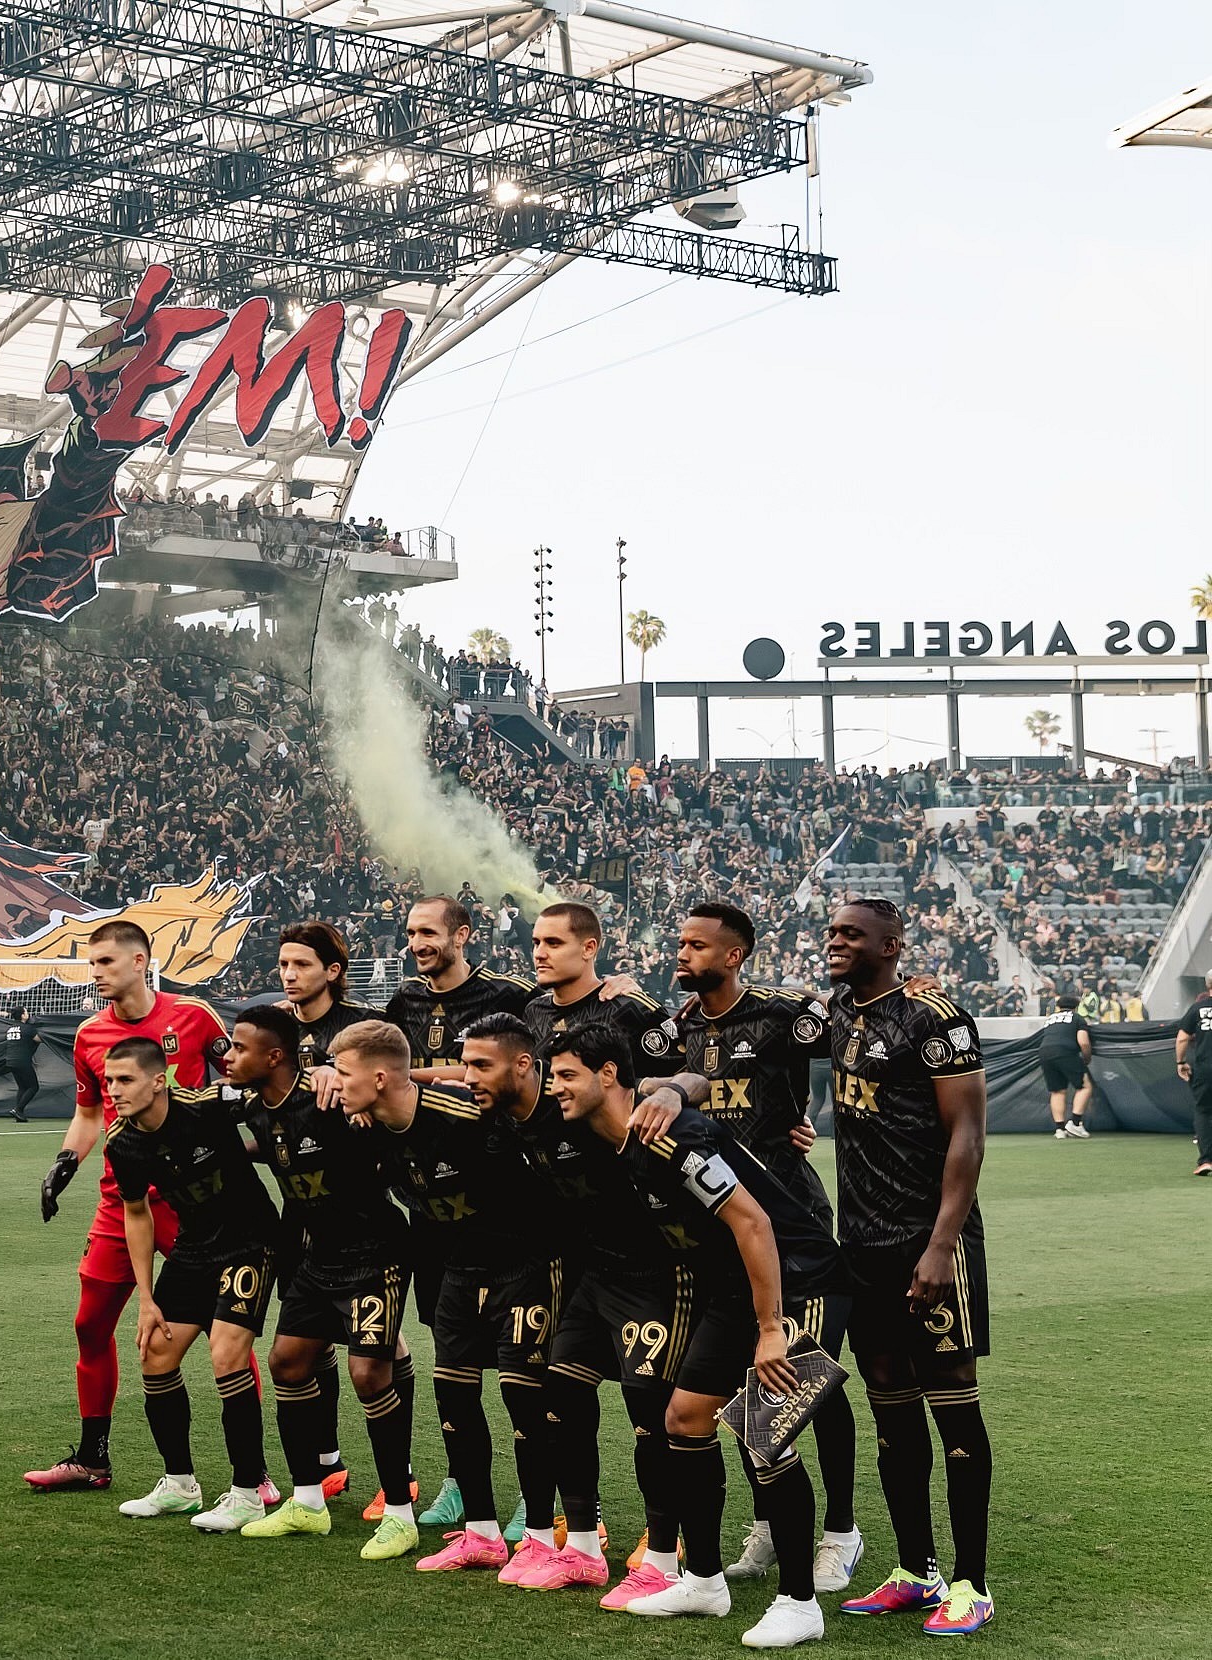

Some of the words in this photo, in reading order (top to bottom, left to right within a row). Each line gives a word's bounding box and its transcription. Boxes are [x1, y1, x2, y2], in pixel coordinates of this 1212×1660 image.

[699, 1078, 752, 1110] EX
[833, 1070, 880, 1112] LEX
[695, 1163, 728, 1195] C
[350, 1295, 385, 1333] 12
[511, 1305, 550, 1344] 19
[621, 1320, 668, 1360] 99
[770, 1380, 810, 1429] STRONG
[803, 1375, 828, 1405] FIVE
[771, 1405, 807, 1446] YEARS
